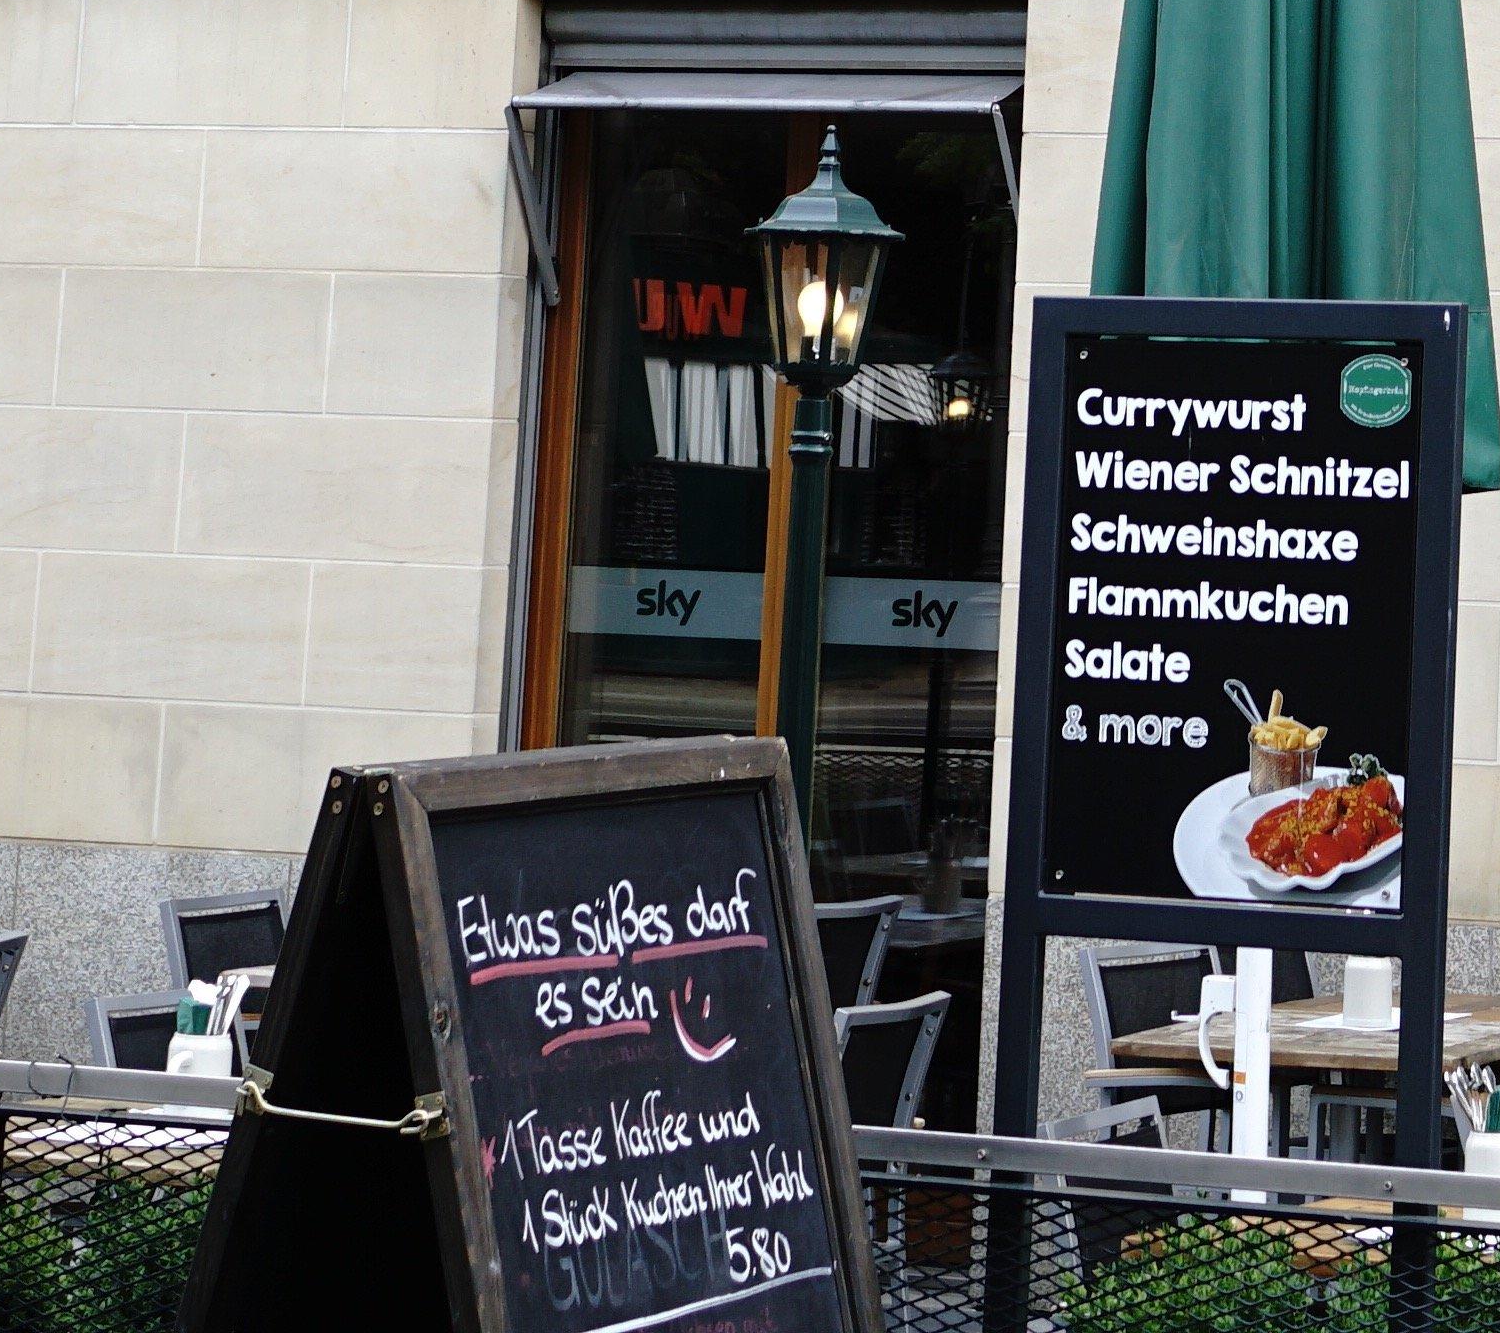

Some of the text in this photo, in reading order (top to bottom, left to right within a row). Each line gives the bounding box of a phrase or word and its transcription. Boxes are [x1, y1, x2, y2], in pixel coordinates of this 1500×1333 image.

[1077, 387, 1307, 436] Currywurst
[1075, 450, 1410, 499] Wiener Schnitzel
[1070, 513, 1359, 562] Schweinshaxe
[636, 580, 701, 626] sky
[891, 590, 959, 637] sky
[1068, 577, 1349, 626] Flammkuchen
[1064, 639, 1191, 683] Salate
[1061, 704, 1209, 748] & more
[457, 893, 561, 963] Etwas
[686, 868, 757, 938] darf
[535, 975, 658, 1028] es sein
[500, 1089, 760, 1181] 1 Tasse Kaffee und
[522, 1142, 814, 1254] 1 Stück Kuchen Ihrer Wahl
[725, 1226, 792, 1283] 5.80
